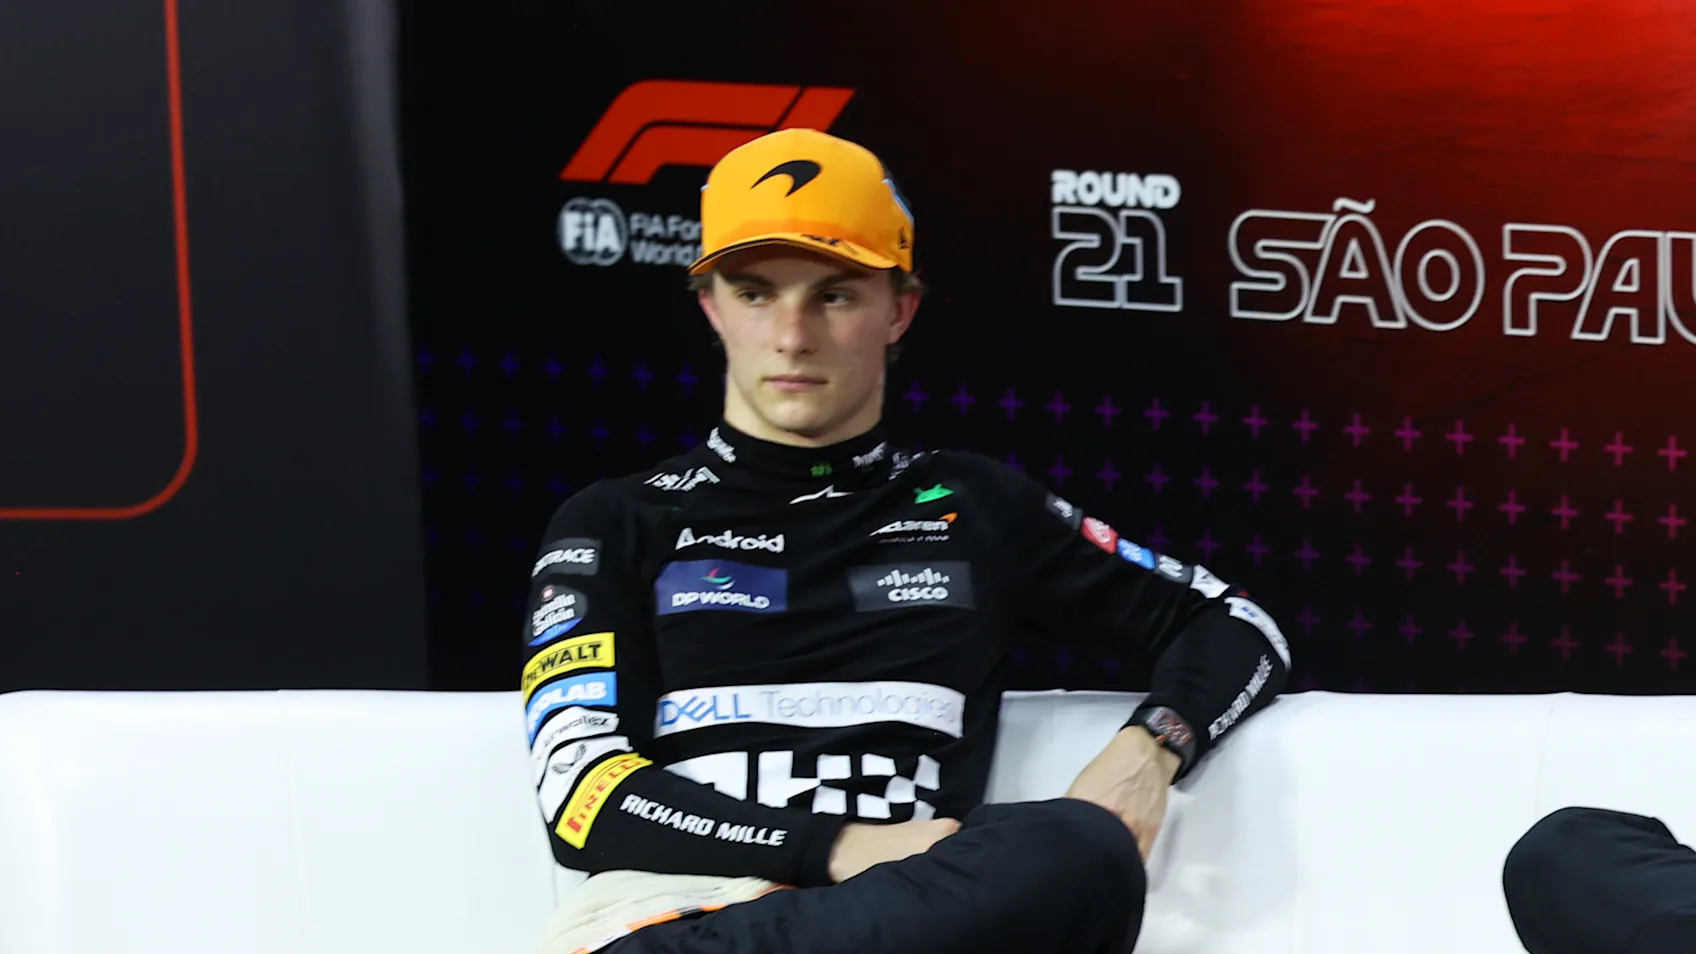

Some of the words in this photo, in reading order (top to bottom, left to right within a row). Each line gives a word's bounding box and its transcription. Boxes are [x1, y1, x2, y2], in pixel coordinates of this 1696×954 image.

[1052, 170, 1181, 208] ROUND
[1052, 207, 1184, 312] 21
[1229, 198, 1486, 332] SÃO
[675, 526, 786, 554] Android
[700, 591, 771, 610] WORLD
[660, 694, 751, 727] DELL
[757, 689, 958, 725] Technologies
[619, 793, 712, 837] RICHARD
[714, 819, 789, 848] MILLE
